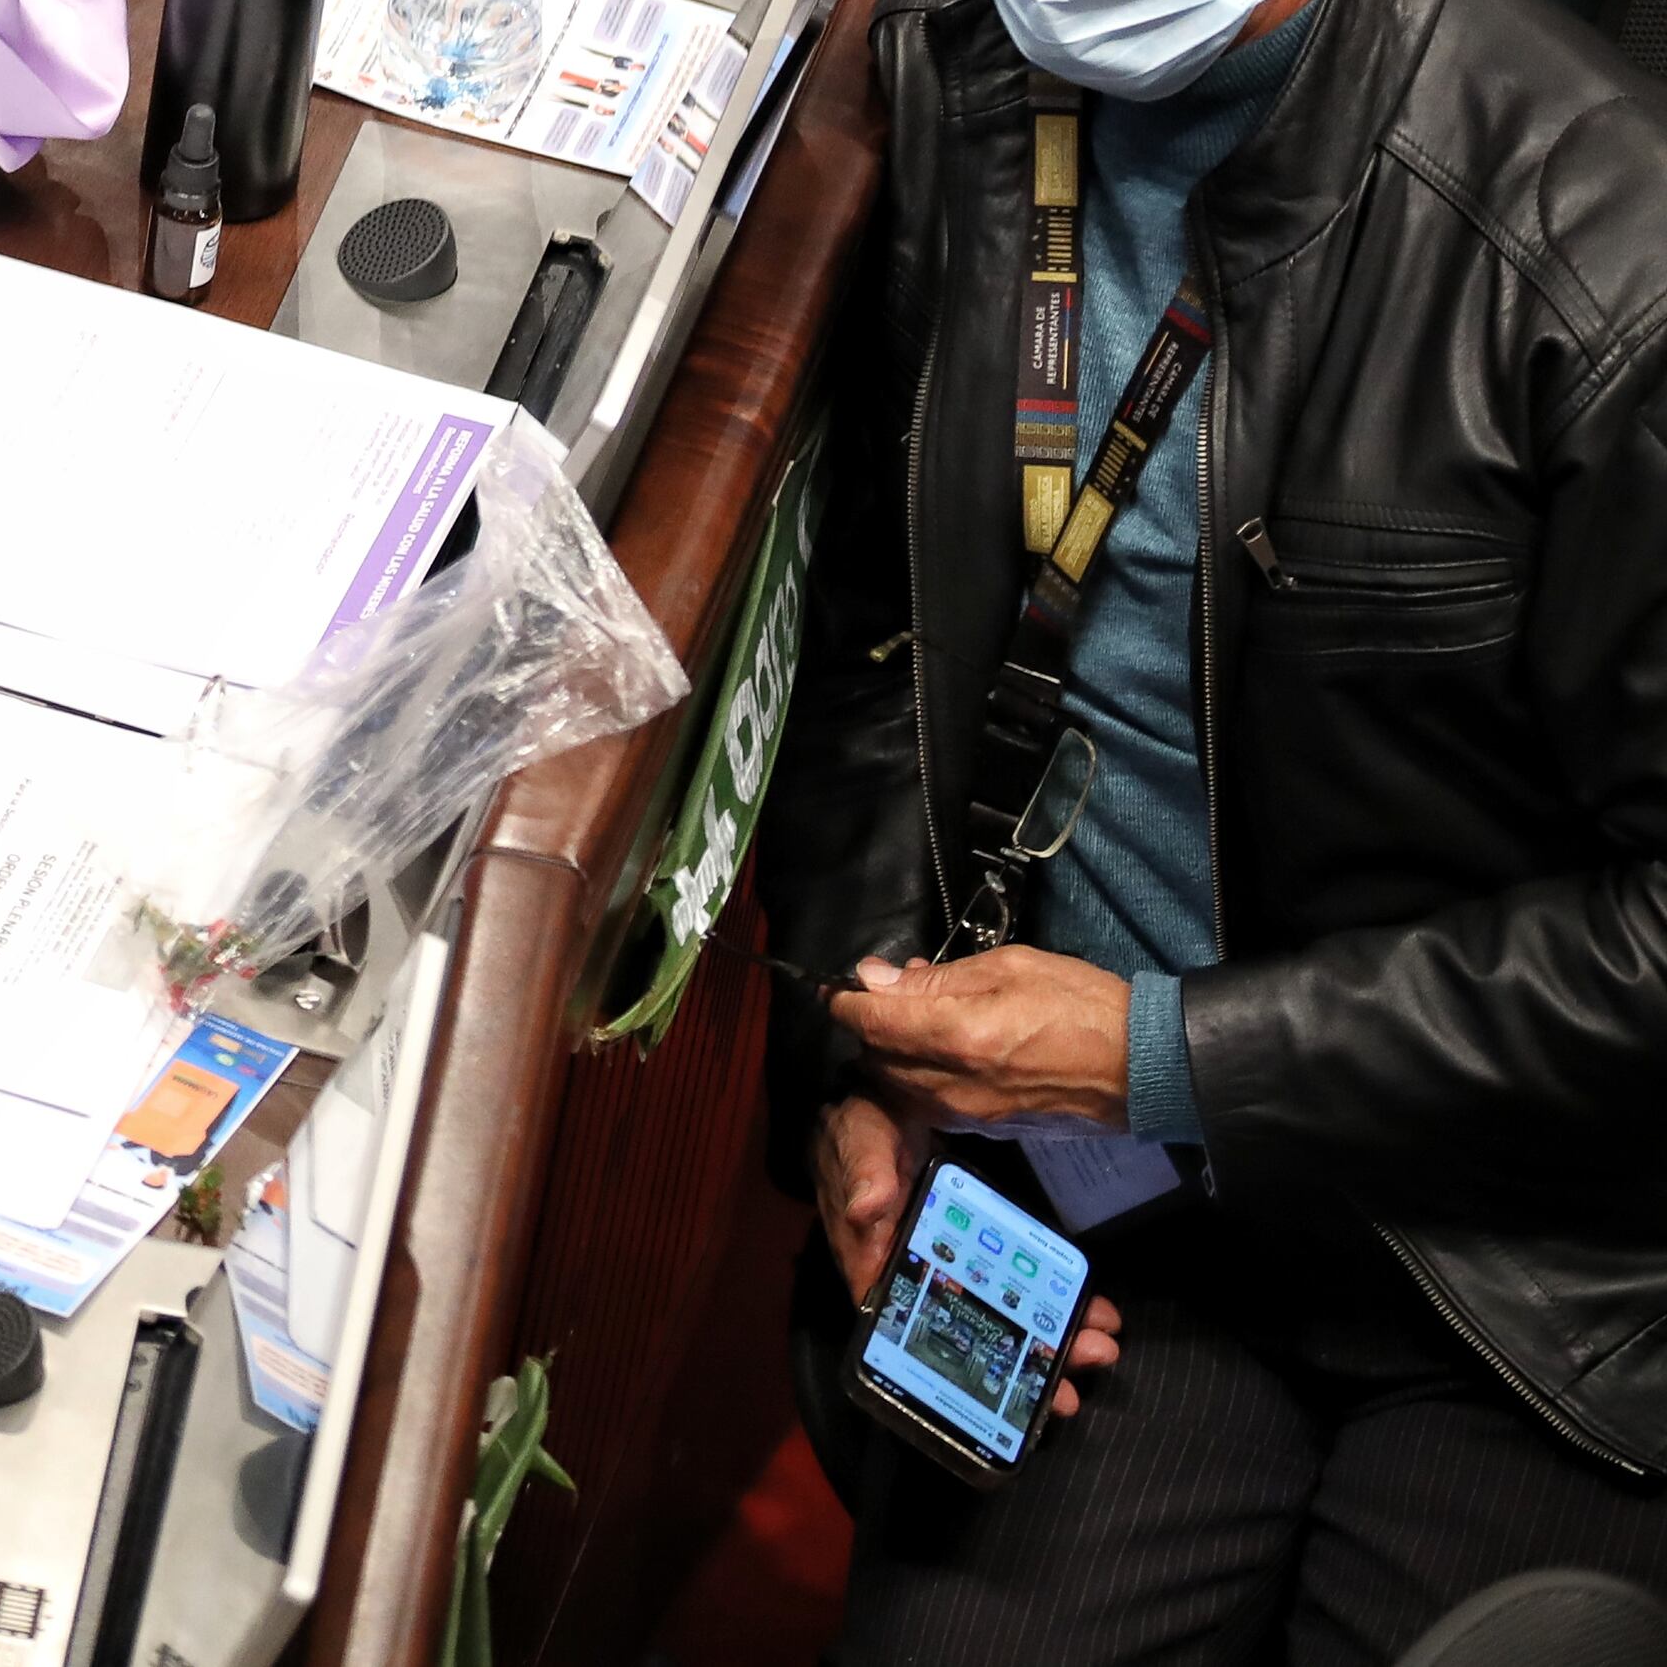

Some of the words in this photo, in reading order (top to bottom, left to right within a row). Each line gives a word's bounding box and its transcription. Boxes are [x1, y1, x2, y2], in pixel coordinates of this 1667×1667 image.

[1035, 306, 1046, 321] DE
[1046, 292, 1061, 385] REPRESENTANTES
[440, 428, 474, 479] REFORMA
[405, 497, 434, 535] SALUD
[382, 553, 403, 577] LAS
[393, 531, 416, 558] CON
[357, 573, 393, 623] MUJERES
[27, 852, 57, 898] SESION
